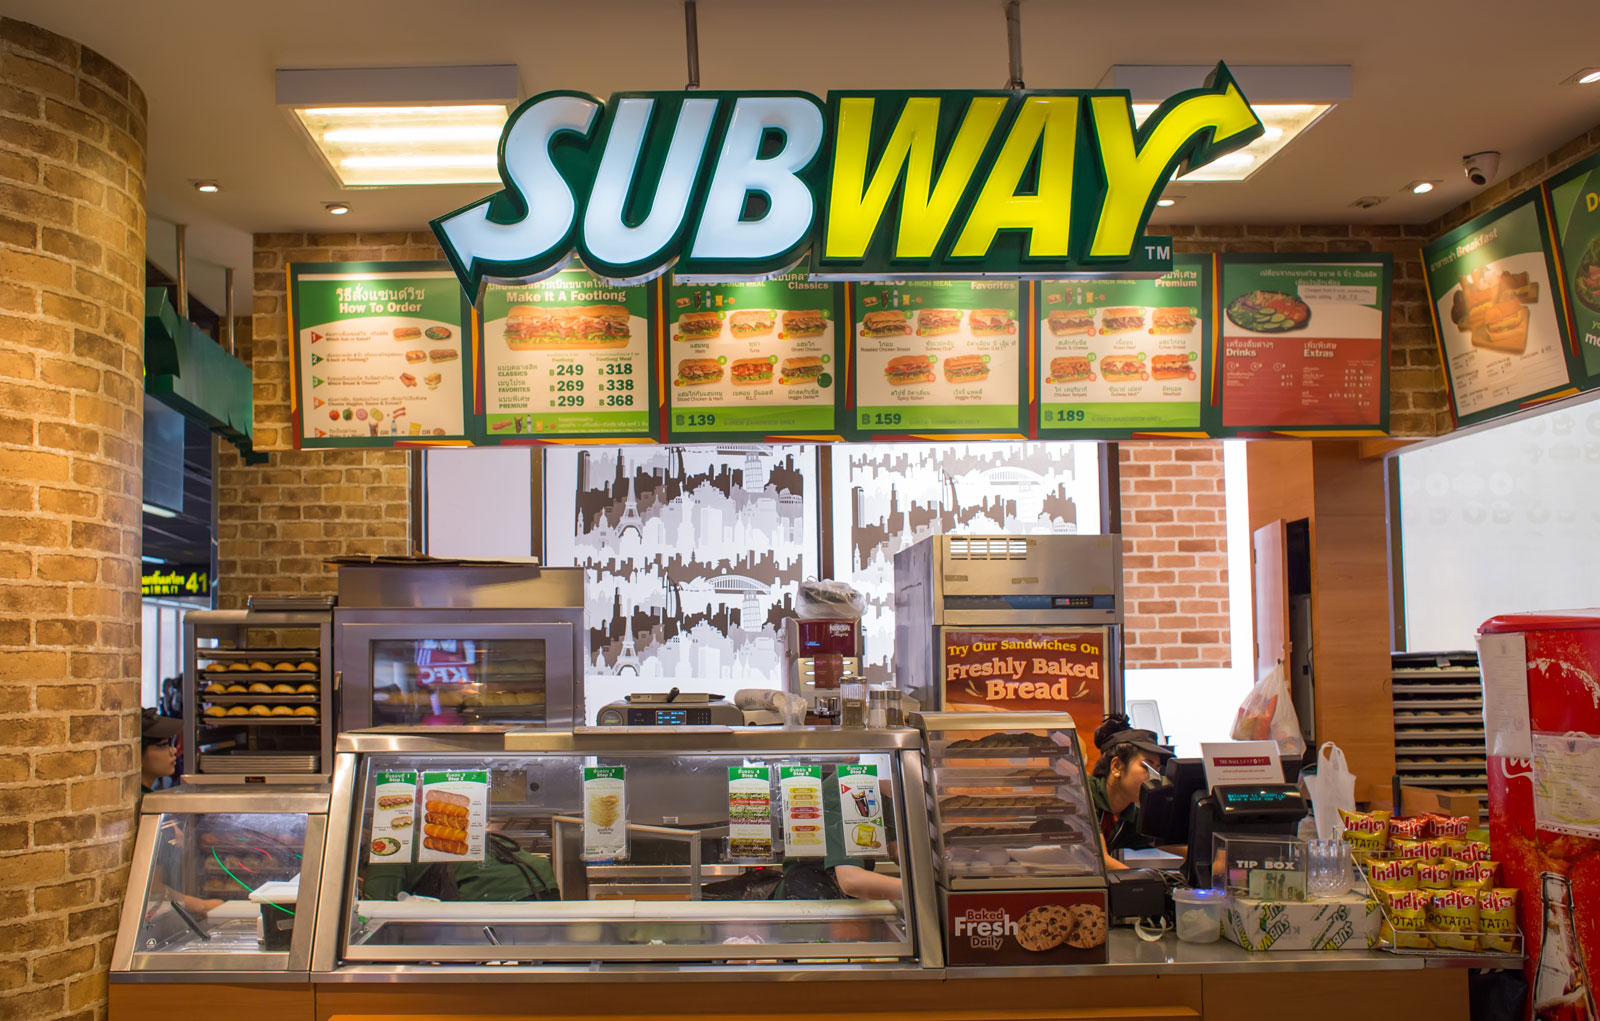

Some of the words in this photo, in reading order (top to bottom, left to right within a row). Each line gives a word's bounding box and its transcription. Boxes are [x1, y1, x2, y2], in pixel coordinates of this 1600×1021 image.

[441, 79, 1260, 267] SUBWAY
[1585, 192, 1600, 213] D
[1456, 228, 1499, 258] Breakfast
[1145, 246, 1171, 260] TM
[788, 281, 830, 290] Classics
[970, 281, 1016, 290] Favorites
[1155, 279, 1198, 287] Premium
[336, 282, 425, 302] วิธีสั่งแซนด์วิช
[506, 291, 541, 303] Make
[544, 292, 554, 302] It
[557, 291, 568, 301] A
[571, 291, 627, 302] Footlong
[339, 303, 367, 313] How
[369, 302, 384, 313] To
[387, 302, 422, 313] Order
[1226, 348, 1257, 357] Drinks
[1303, 349, 1334, 357] Extras
[556, 364, 584, 376] 249
[606, 363, 633, 375] 318
[556, 380, 584, 392] 269
[606, 379, 634, 391] 338
[557, 395, 585, 407] 299
[606, 395, 634, 406] 368
[688, 414, 716, 426] 139
[875, 413, 902, 425] 159
[1057, 410, 1085, 422] 189
[185, 572, 207, 594] 41
[948, 644, 969, 657] Try
[972, 640, 998, 652] Our
[1001, 639, 1077, 652] Sandwiches
[1080, 643, 1099, 655] On
[947, 656, 1027, 681] Freshly
[1032, 657, 1100, 680] Baked
[985, 678, 1070, 701] Bread
[1236, 860, 1259, 869] TIP
[1264, 861, 1296, 870] BOX
[965, 908, 1005, 920] Baked
[954, 913, 1019, 937] Fresh
[1480, 917, 1510, 928] TATO
[970, 936, 1003, 950] Daily
